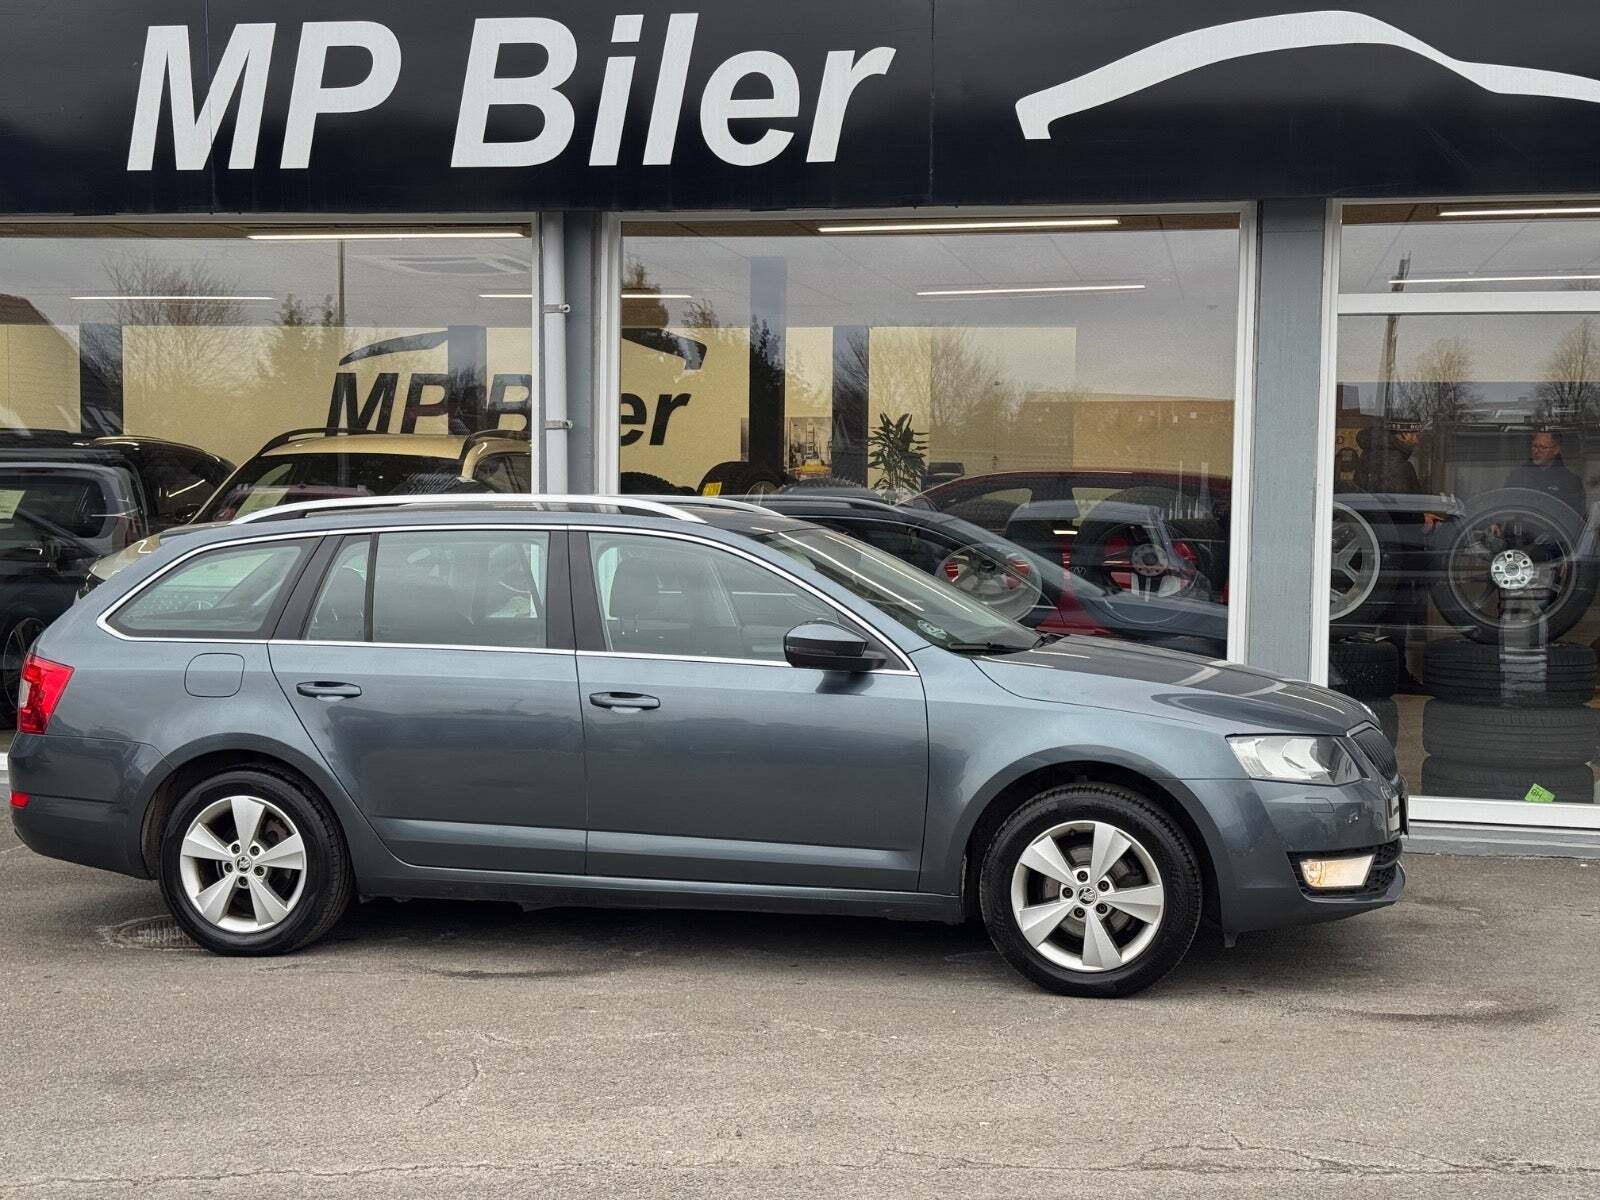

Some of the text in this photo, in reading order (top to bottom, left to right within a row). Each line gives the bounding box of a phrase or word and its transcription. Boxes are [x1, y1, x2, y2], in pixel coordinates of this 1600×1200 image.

[127, 13, 896, 170] MP Biler
[325, 373, 450, 435] MP
